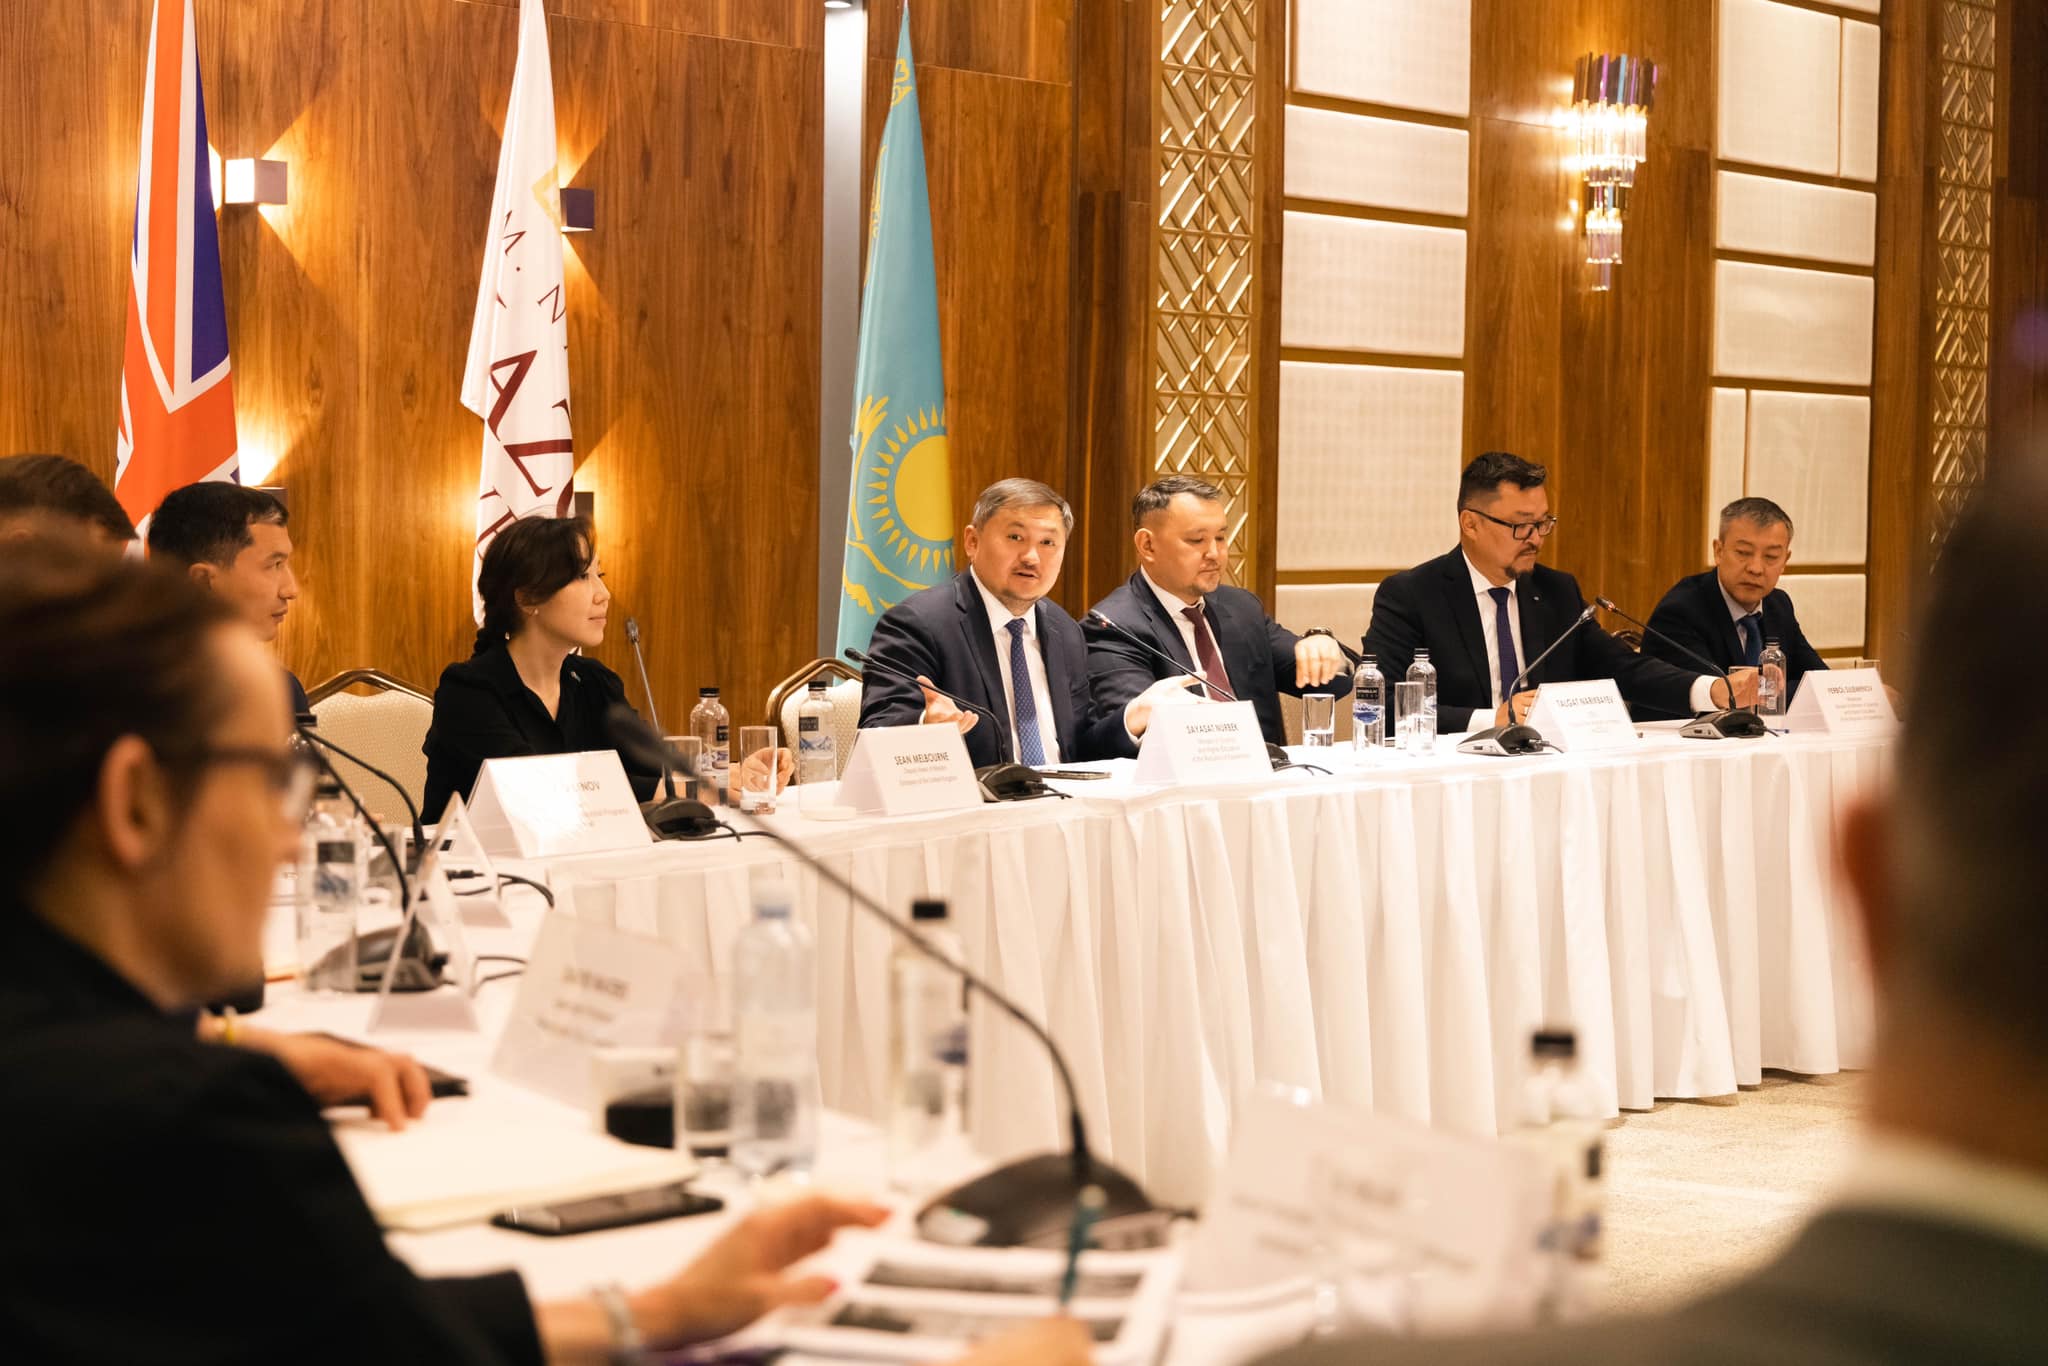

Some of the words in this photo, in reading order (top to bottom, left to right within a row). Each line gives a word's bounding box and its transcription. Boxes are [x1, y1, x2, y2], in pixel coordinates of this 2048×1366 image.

[1186, 724, 1214, 734] SAYASAT
[1215, 723, 1239, 732] NURBEK
[894, 755, 912, 765] SEAN
[912, 752, 949, 762] MELBOURNE
